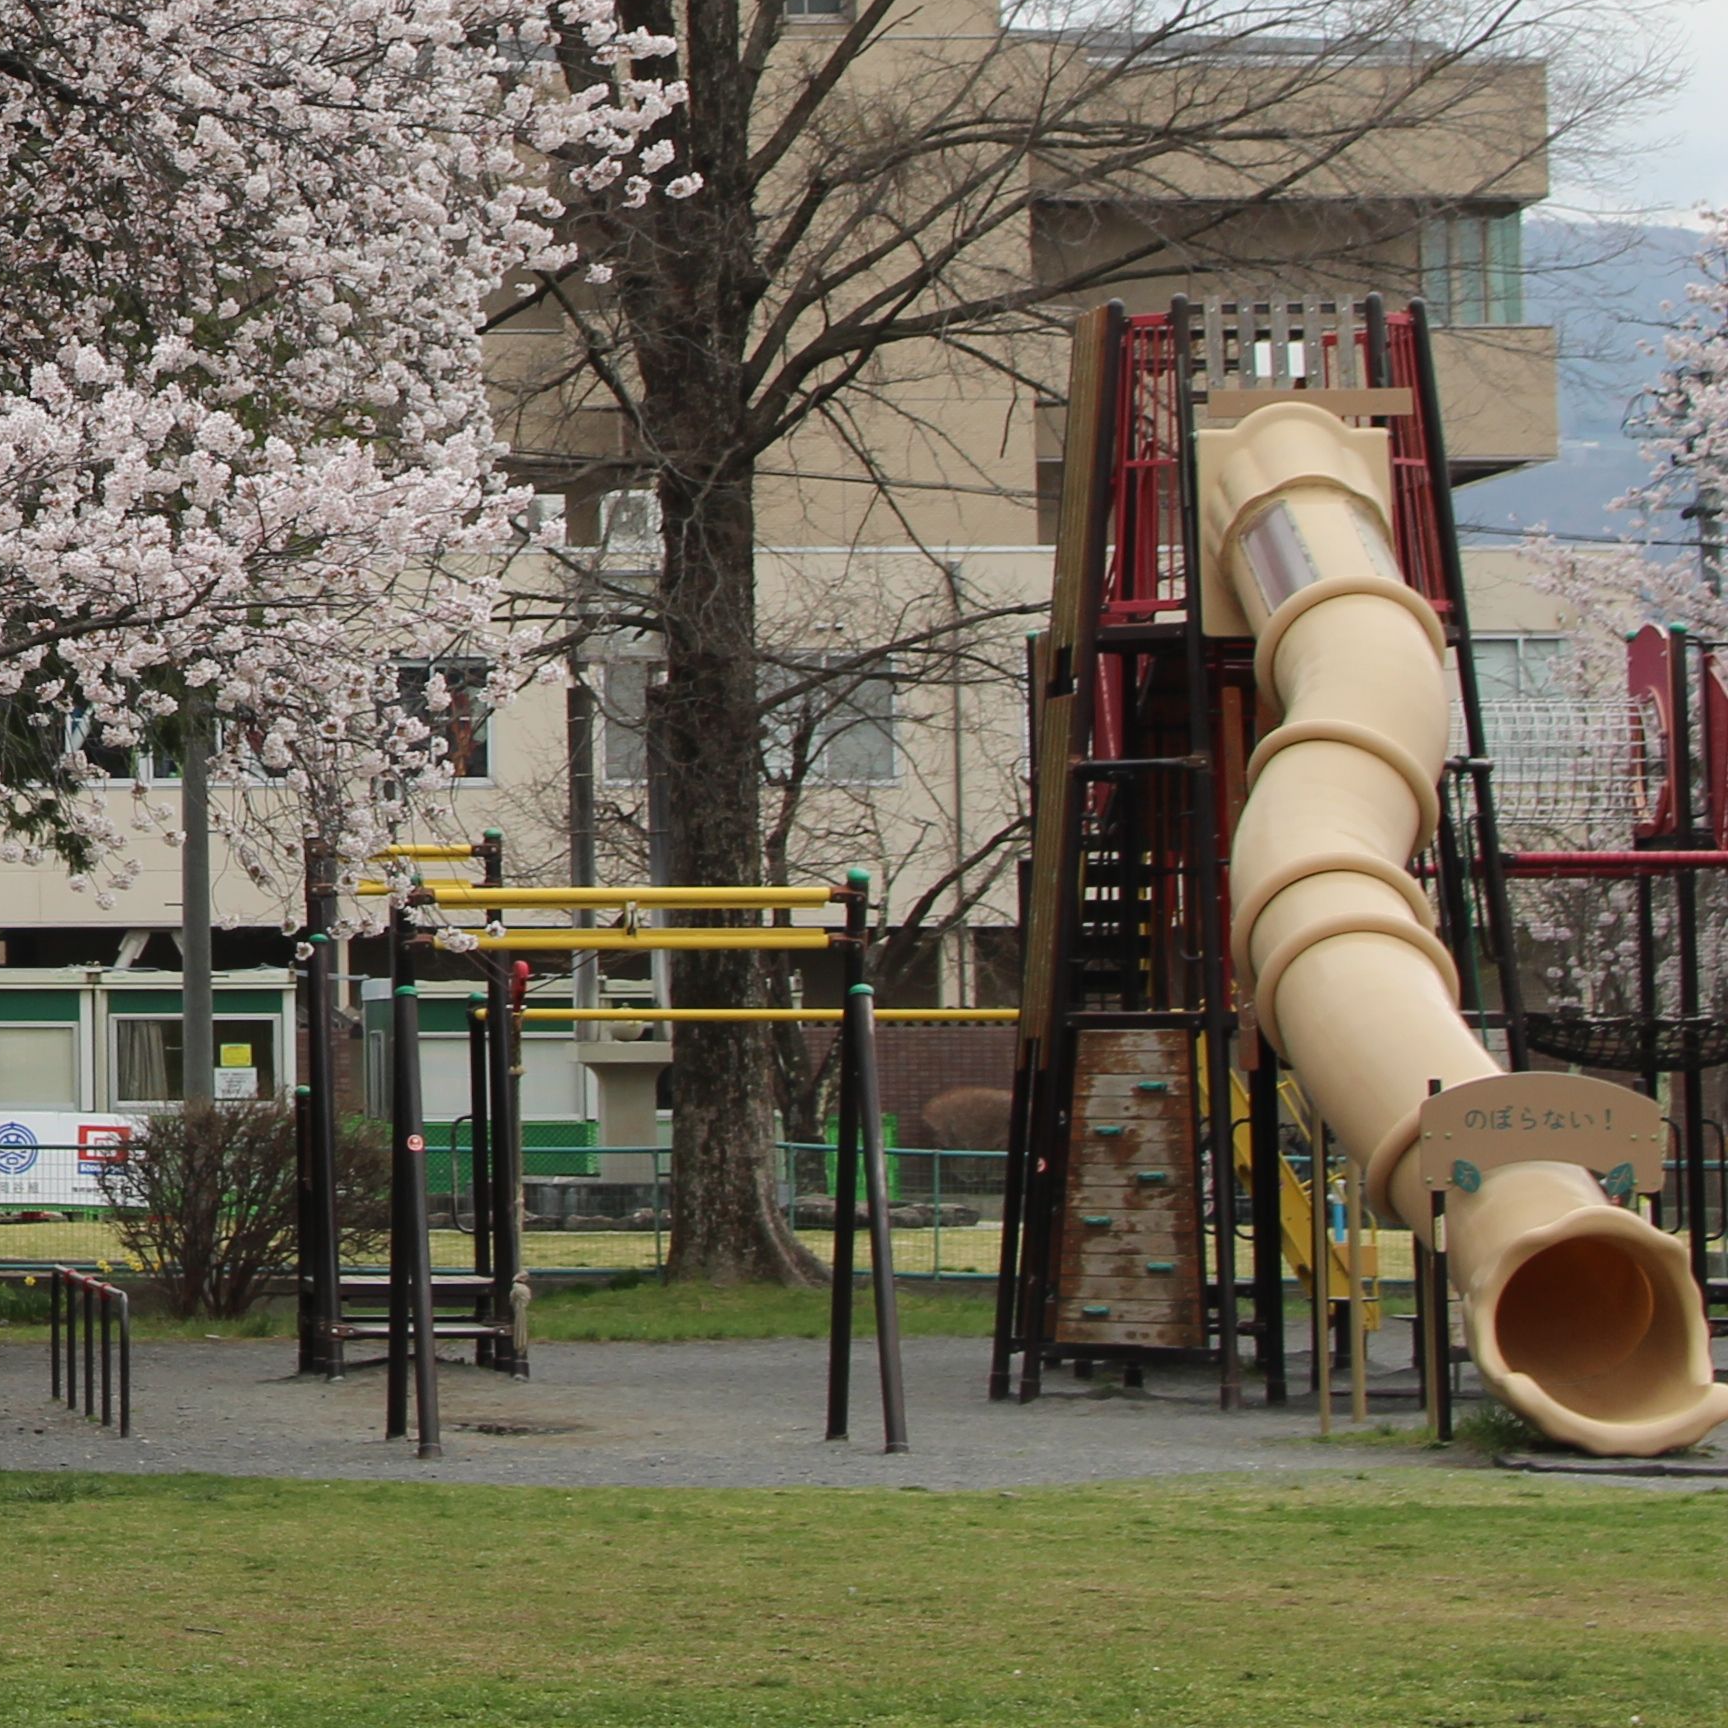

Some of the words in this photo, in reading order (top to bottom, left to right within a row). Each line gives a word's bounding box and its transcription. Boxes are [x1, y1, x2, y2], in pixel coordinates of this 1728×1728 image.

[1464, 1105, 1611, 1130] のぼらない!
